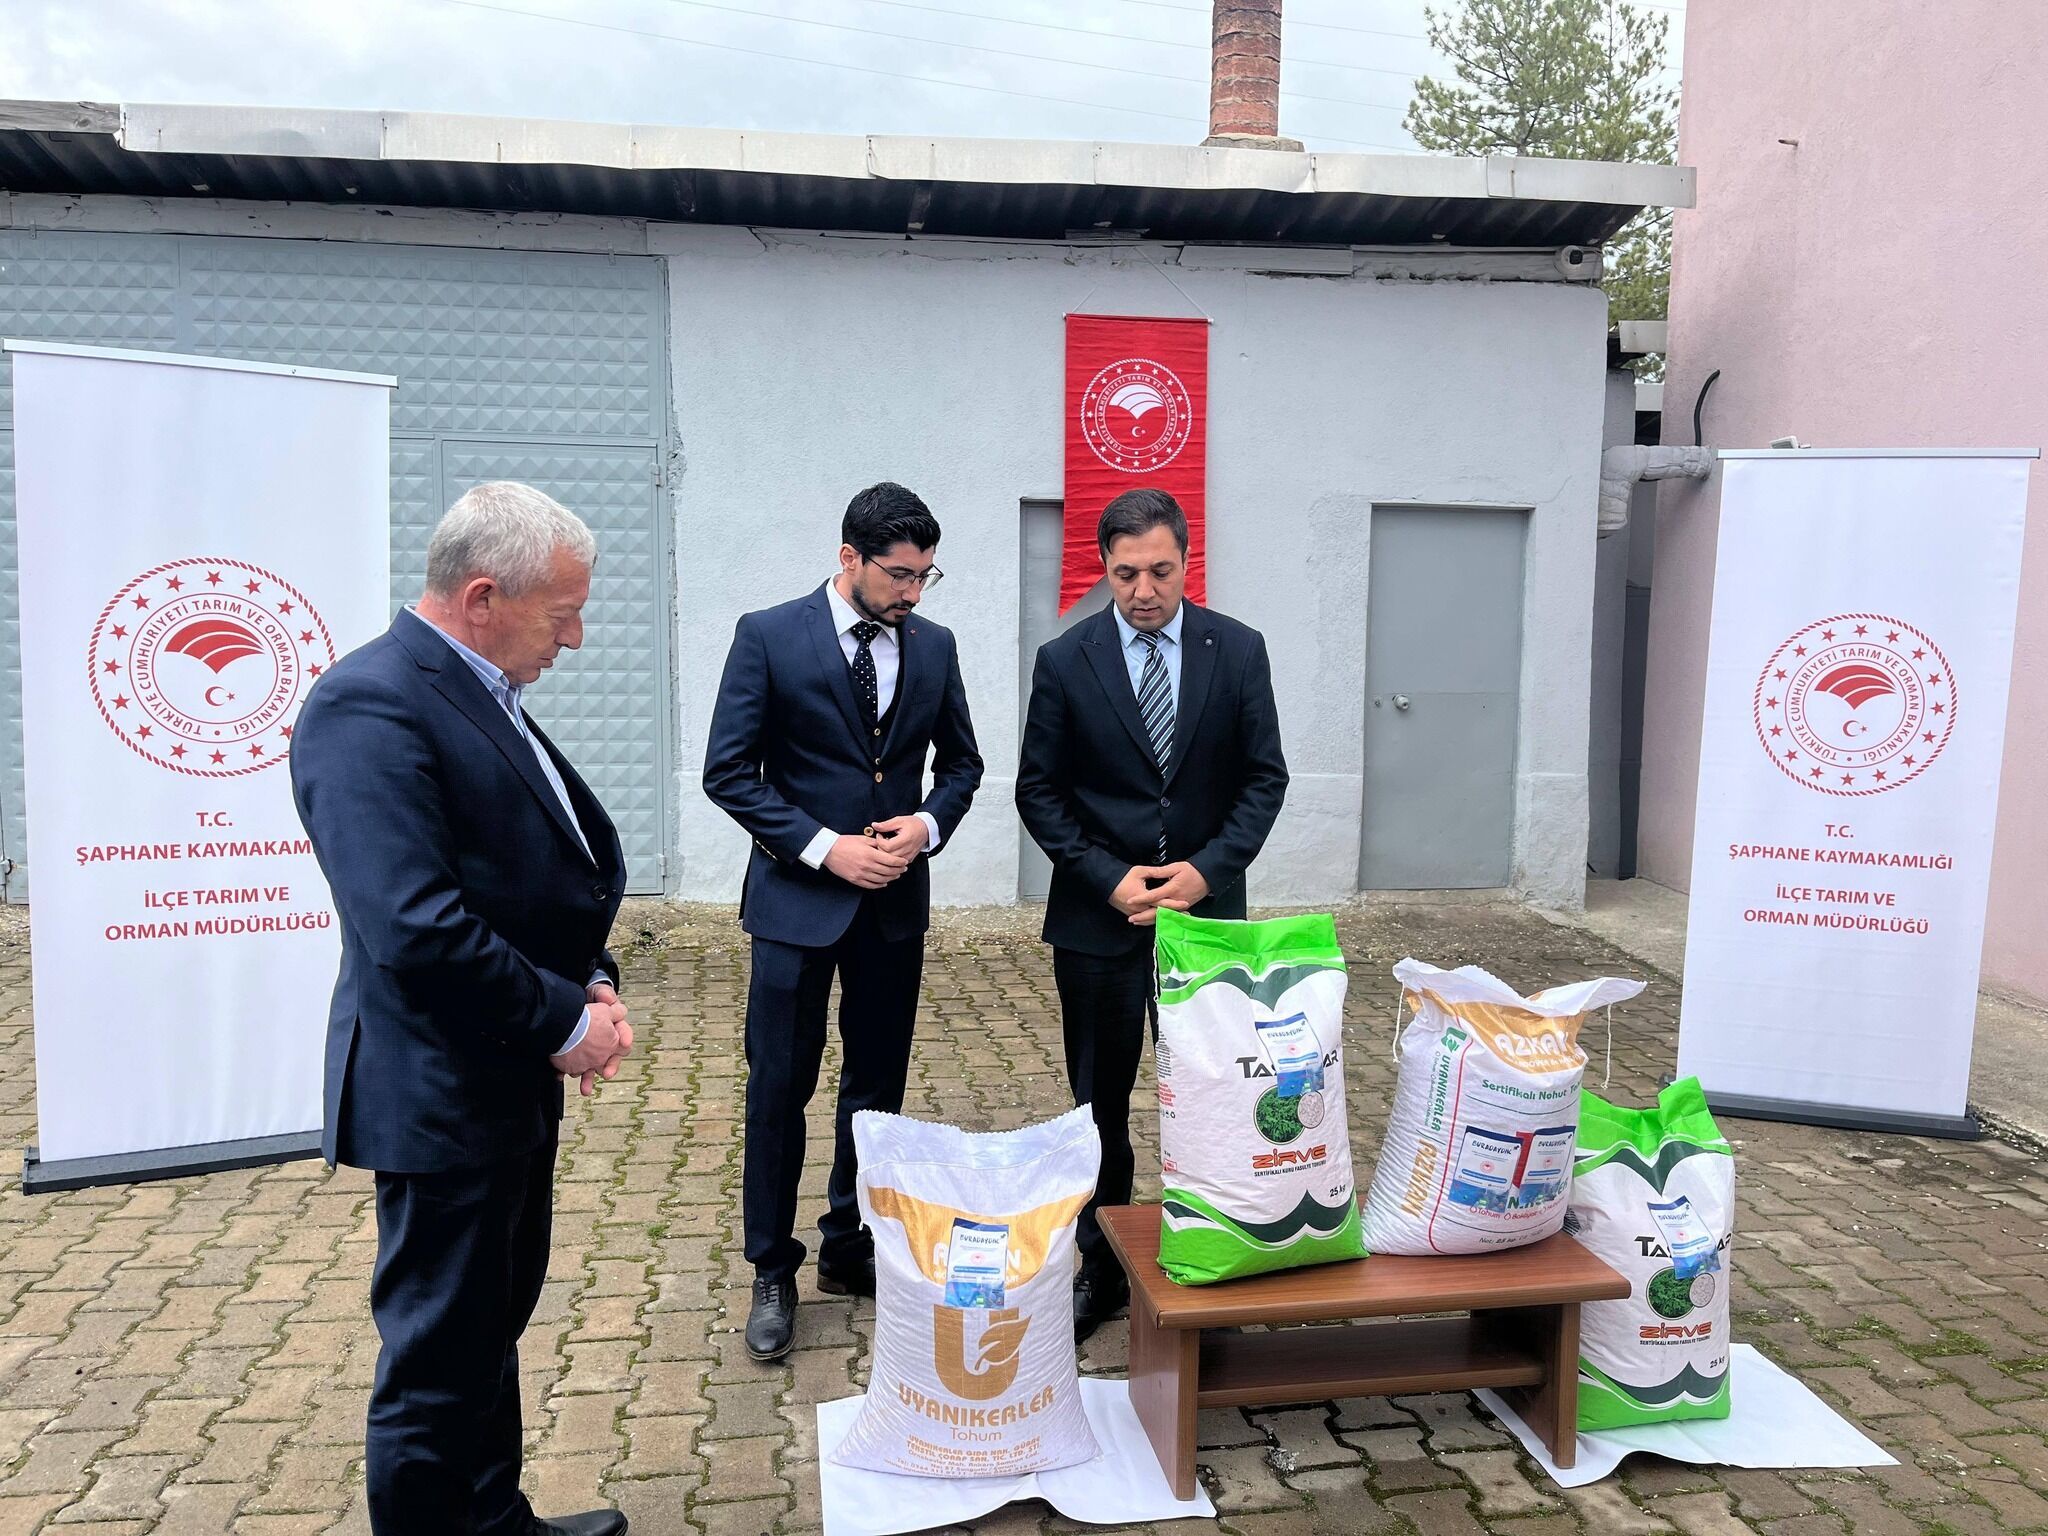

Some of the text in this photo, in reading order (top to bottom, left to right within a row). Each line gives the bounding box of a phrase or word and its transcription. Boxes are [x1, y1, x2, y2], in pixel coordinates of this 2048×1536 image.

[137, 599, 293, 735] TÜRKİYE CUMHURİYETİ TARIM VE ORMAN BAKANLIĞI
[1791, 648, 1919, 761] TÜRKİYE CUMHURİYETİ TARIM VE ORMAN BAKANLIĞI
[196, 812, 233, 827] T.C.
[1825, 824, 1854, 838] T.C.
[76, 840, 315, 866] ŞAPHANE KAYMAKAM
[1729, 844, 1953, 870] ŞAPHANE KAYMAKAMLIĞI
[144, 886, 290, 911] İLÇE TARIM VE
[1776, 883, 1896, 906] İLÇE TARIM VE
[105, 911, 331, 940] ORMAN MÜDÜRLÜĞÜ
[1744, 909, 1929, 935] ORMAN MÜDÜRLÜĞÜ
[1482, 1080, 1535, 1100] Sertifikalı
[1539, 1089, 1567, 1100] Nohut
[1254, 1169, 1281, 1177] SERTİFİKALI
[1329, 1187, 1339, 1198] 25
[1477, 1208, 1501, 1219] Tohum
[1709, 1359, 1718, 1368] 25
[899, 1382, 1055, 1427] UYANIKERLER
[950, 1427, 1002, 1441] Tohum
